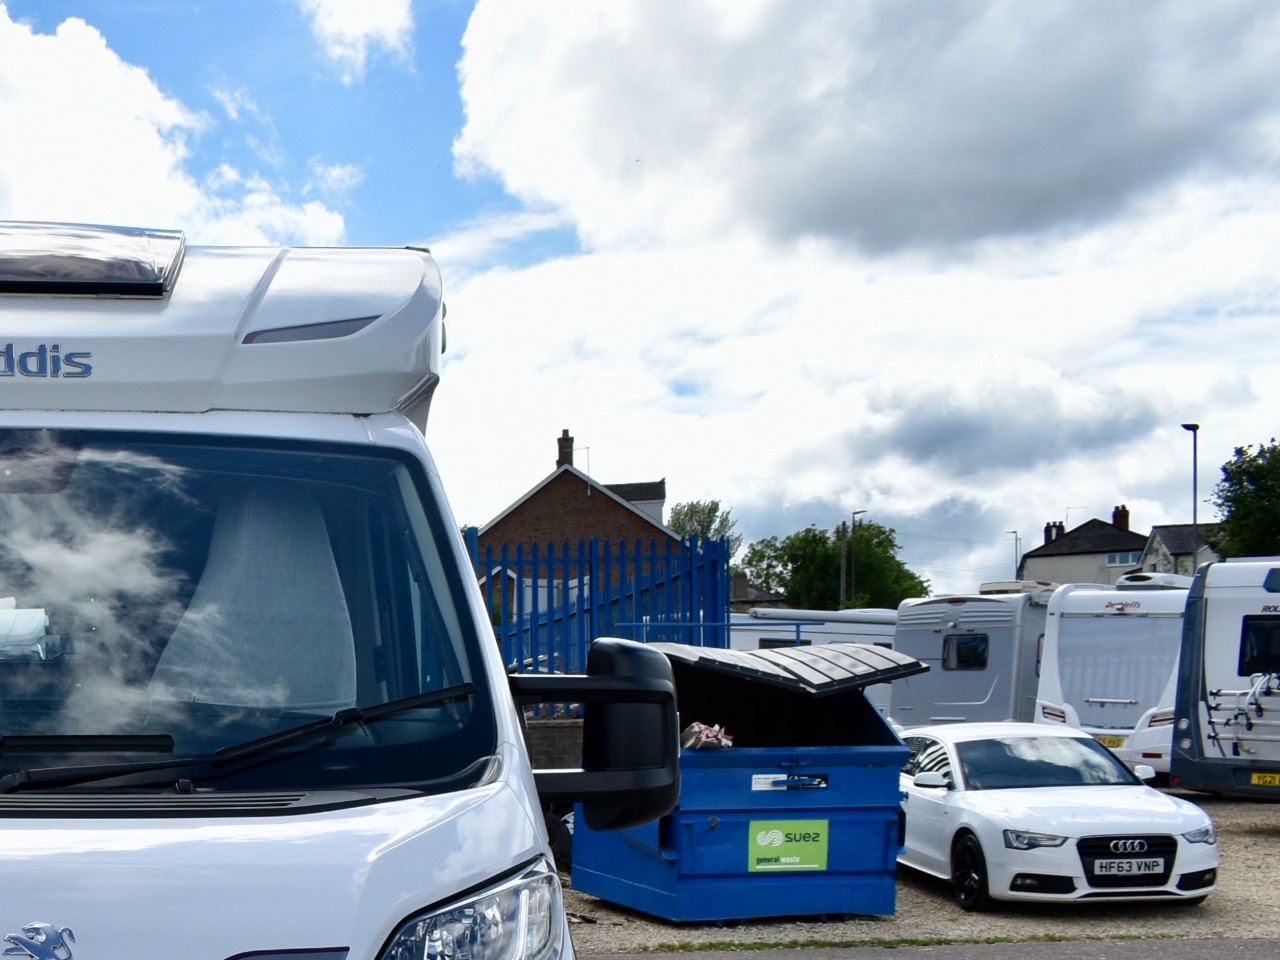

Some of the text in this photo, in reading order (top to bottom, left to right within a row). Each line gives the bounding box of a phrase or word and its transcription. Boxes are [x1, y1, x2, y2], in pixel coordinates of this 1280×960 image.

[785, 832, 820, 843] suez
[756, 856, 780, 865] general
[1099, 860, 1161, 873] HF63 VNP
